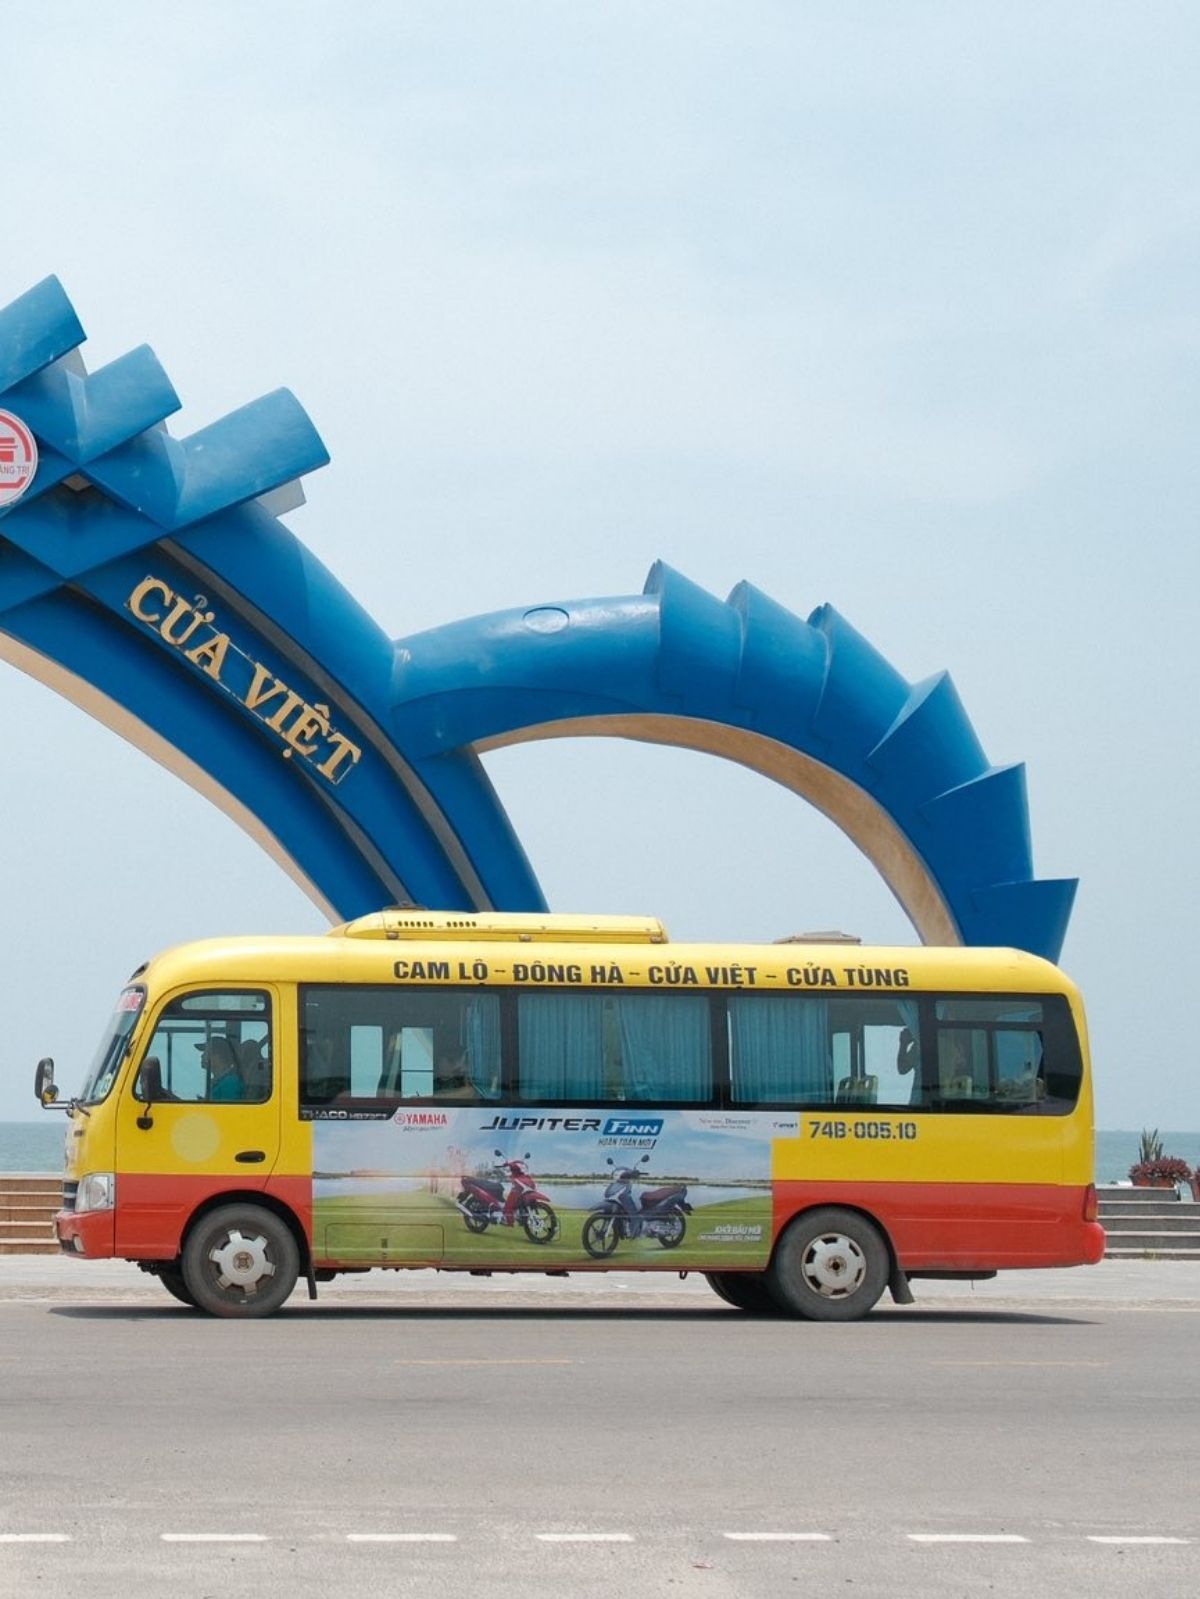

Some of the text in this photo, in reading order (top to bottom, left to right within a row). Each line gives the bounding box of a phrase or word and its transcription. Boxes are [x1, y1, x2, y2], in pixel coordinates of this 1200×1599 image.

[128, 576, 362, 780] CỬA VIỆT
[393, 961, 450, 980] CAM
[458, 958, 488, 985] LỘ
[512, 960, 582, 983] ĐÔNG
[590, 961, 624, 984] HÀ
[648, 960, 699, 985] CỬA
[705, 963, 757, 989] VIỆT
[786, 961, 837, 987] CỬA
[843, 964, 909, 987] TÙNG
[301, 1109, 348, 1120] THACO
[406, 1113, 448, 1125] YAMAHA
[479, 1116, 602, 1132] JUPITER
